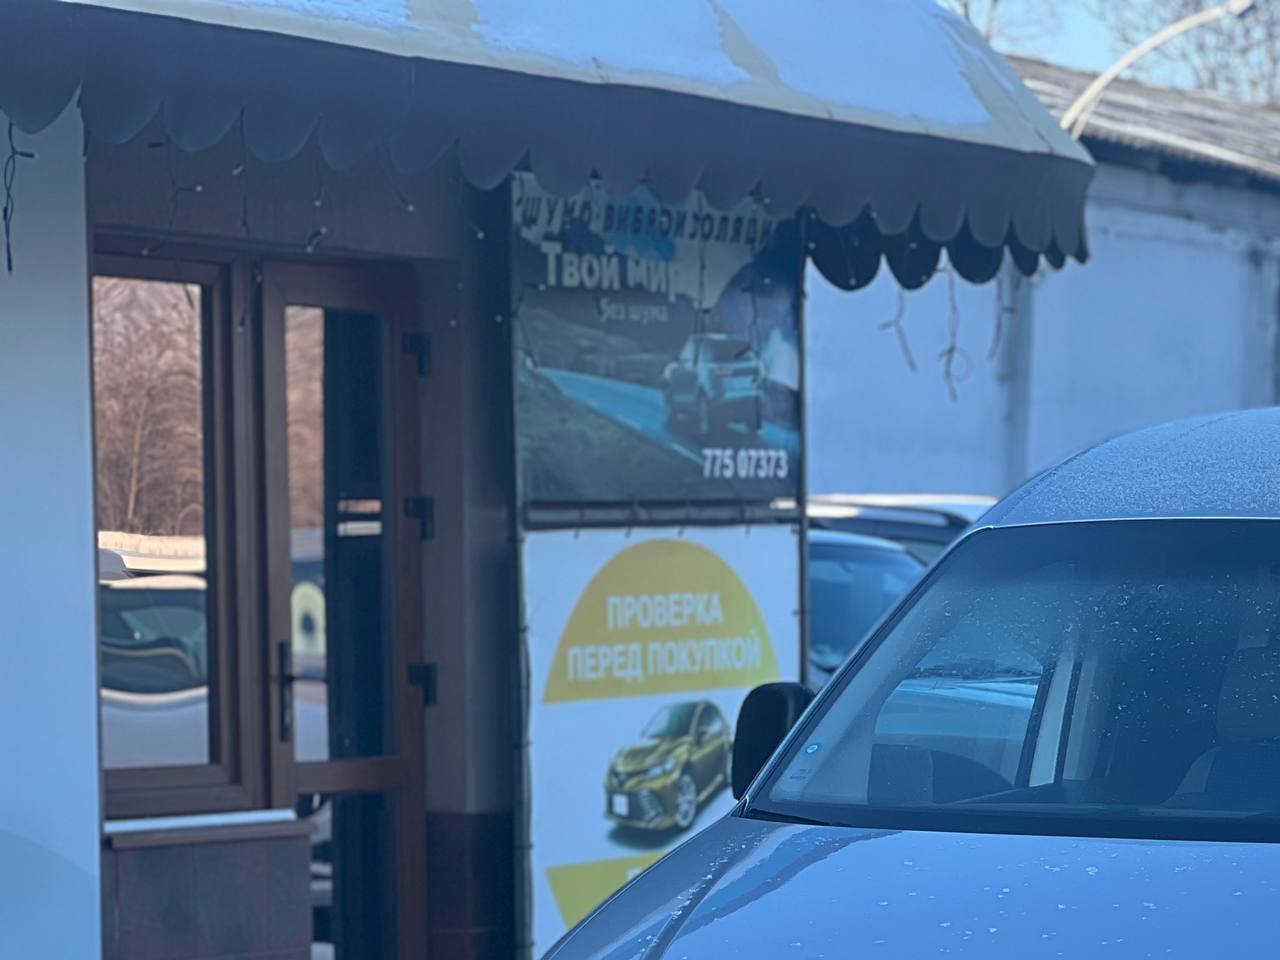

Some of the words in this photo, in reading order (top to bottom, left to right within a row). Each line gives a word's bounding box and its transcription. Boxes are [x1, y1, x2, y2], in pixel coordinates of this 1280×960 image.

[540, 241, 621, 290] Твой
[702, 448, 735, 479] 775
[737, 448, 788, 480] 07373
[607, 594, 724, 631] ПРОВЕРКА
[568, 642, 643, 683] ПЕРЕД
[648, 629, 761, 674] ПОКУПКОЙ
